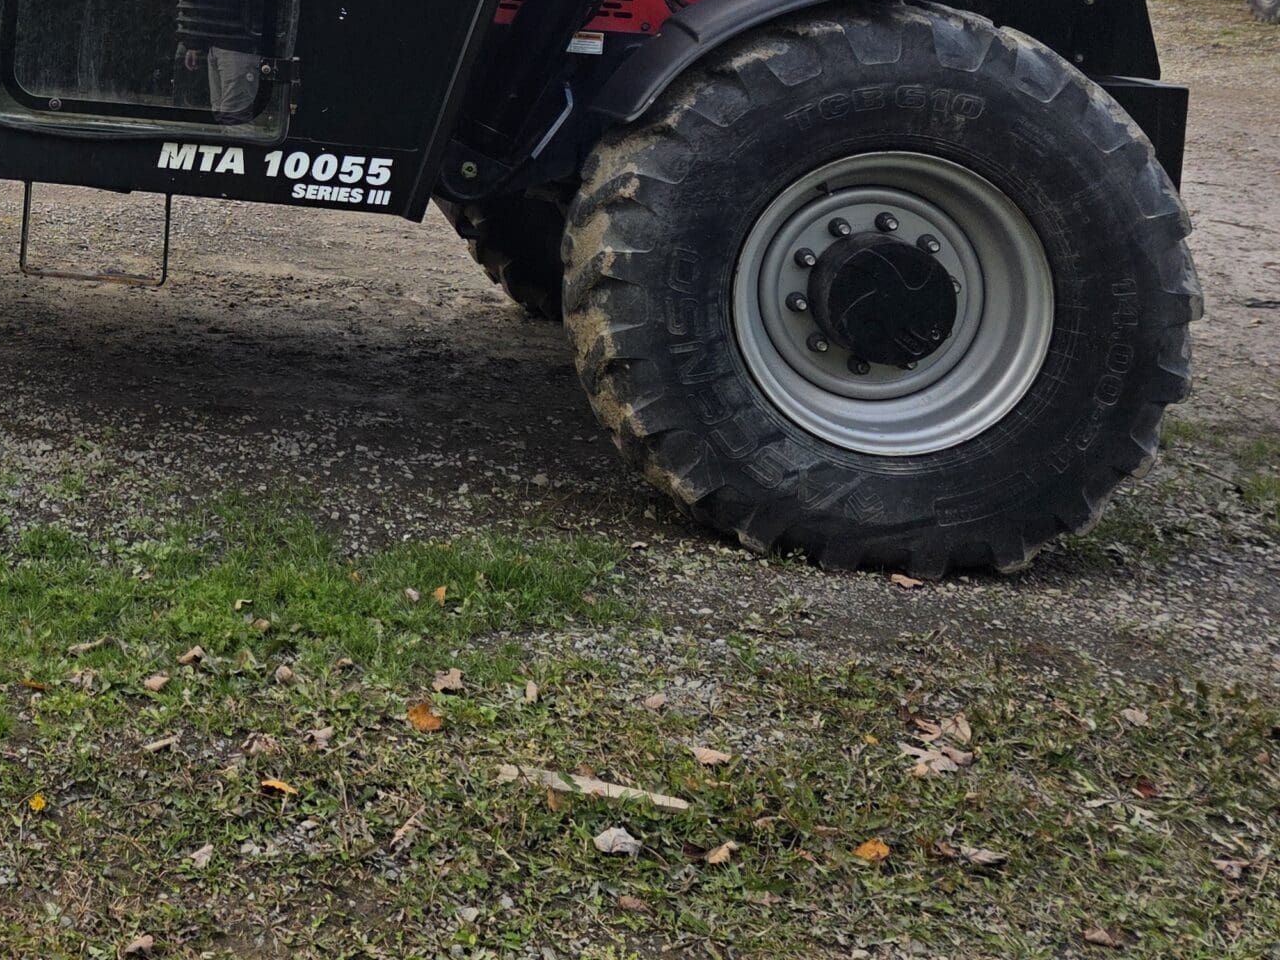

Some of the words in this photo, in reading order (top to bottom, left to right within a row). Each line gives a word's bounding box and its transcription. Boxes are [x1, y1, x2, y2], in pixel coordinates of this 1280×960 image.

[894, 84, 986, 120] 610
[157, 142, 245, 175] MTA
[264, 150, 394, 186] 10055
[291, 184, 364, 203] SERIES
[366, 189, 392, 206] III
